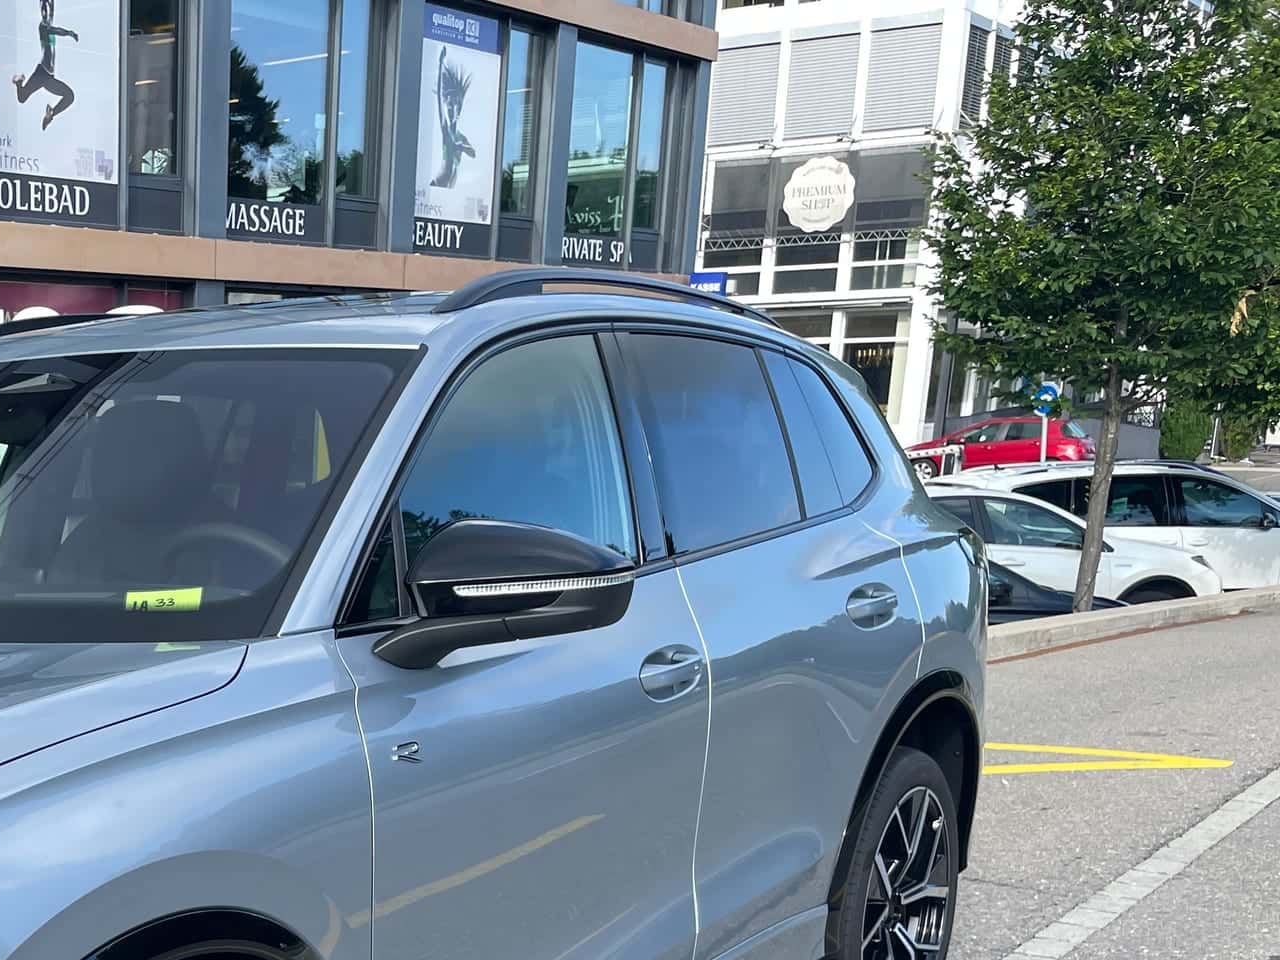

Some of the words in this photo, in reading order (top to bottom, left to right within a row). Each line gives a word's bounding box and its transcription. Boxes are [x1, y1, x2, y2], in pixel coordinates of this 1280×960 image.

[791, 183, 847, 199] PREMIUM
[412, 220, 464, 249] EAUTY
[155, 597, 177, 608] 33
